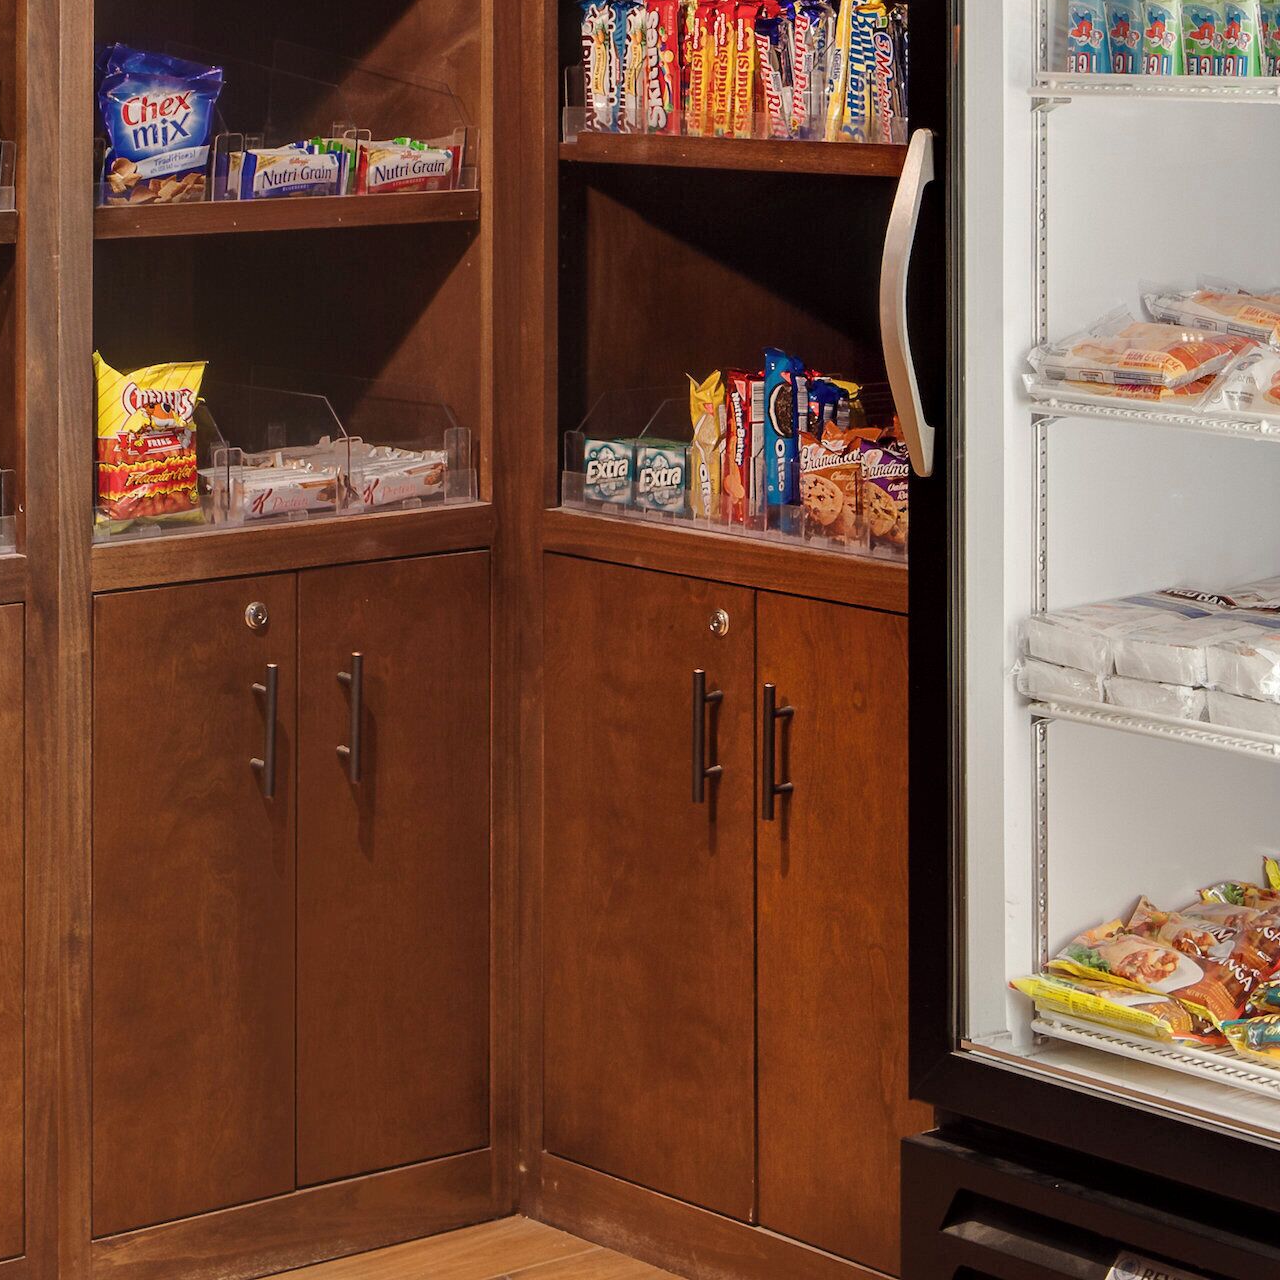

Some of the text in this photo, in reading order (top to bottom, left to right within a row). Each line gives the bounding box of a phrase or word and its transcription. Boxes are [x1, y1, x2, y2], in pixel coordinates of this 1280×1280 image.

[121, 90, 194, 127] Chex
[131, 111, 191, 151] mix
[1126, 352, 1144, 362] HAM
[730, 391, 746, 466] Nutter Butter
[585, 457, 629, 484] Extra
[639, 463, 682, 489] Extra
[774, 437, 787, 493] OREO
[251, 487, 274, 515] K
[363, 477, 381, 506] K
